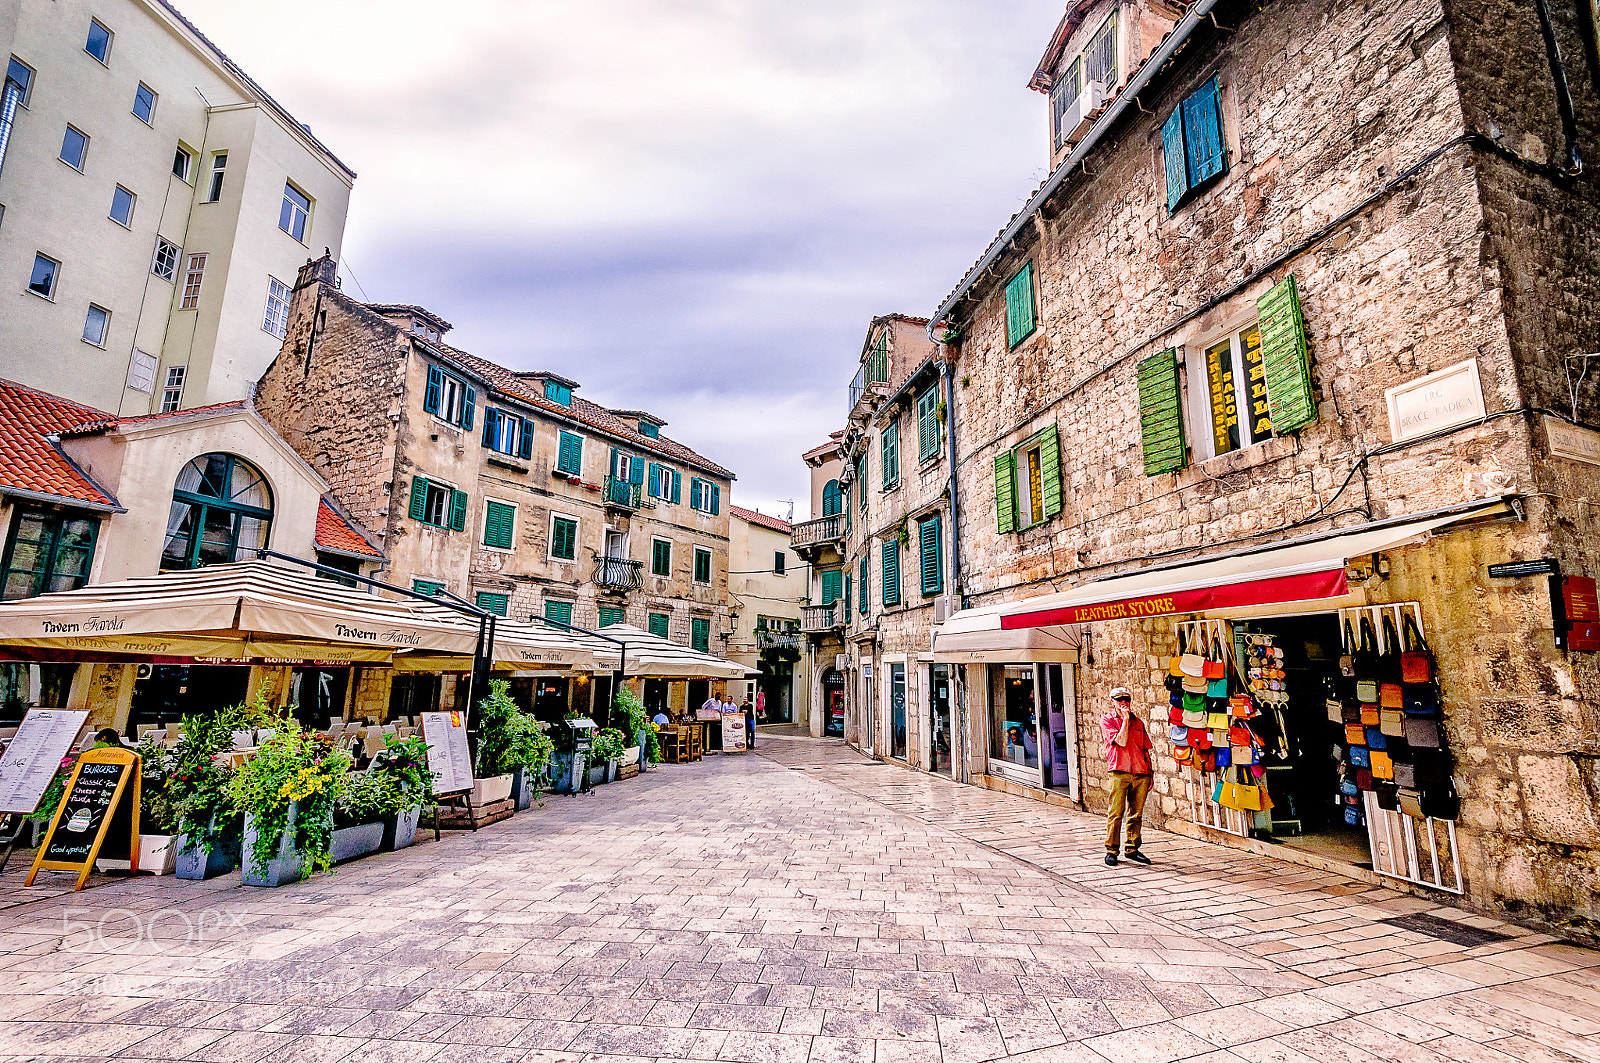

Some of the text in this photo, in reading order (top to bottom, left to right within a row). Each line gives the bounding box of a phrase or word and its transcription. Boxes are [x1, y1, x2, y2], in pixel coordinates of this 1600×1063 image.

[1246, 332, 1273, 435] STELLA
[1208, 351, 1226, 447] FRIZERSKI
[1222, 370, 1238, 427] SALON
[1074, 597, 1176, 621] LEATHER STORE
[42, 615, 125, 633] Tavern Favola
[335, 623, 422, 645] Tavern Favola
[520, 650, 542, 660] Tavern
